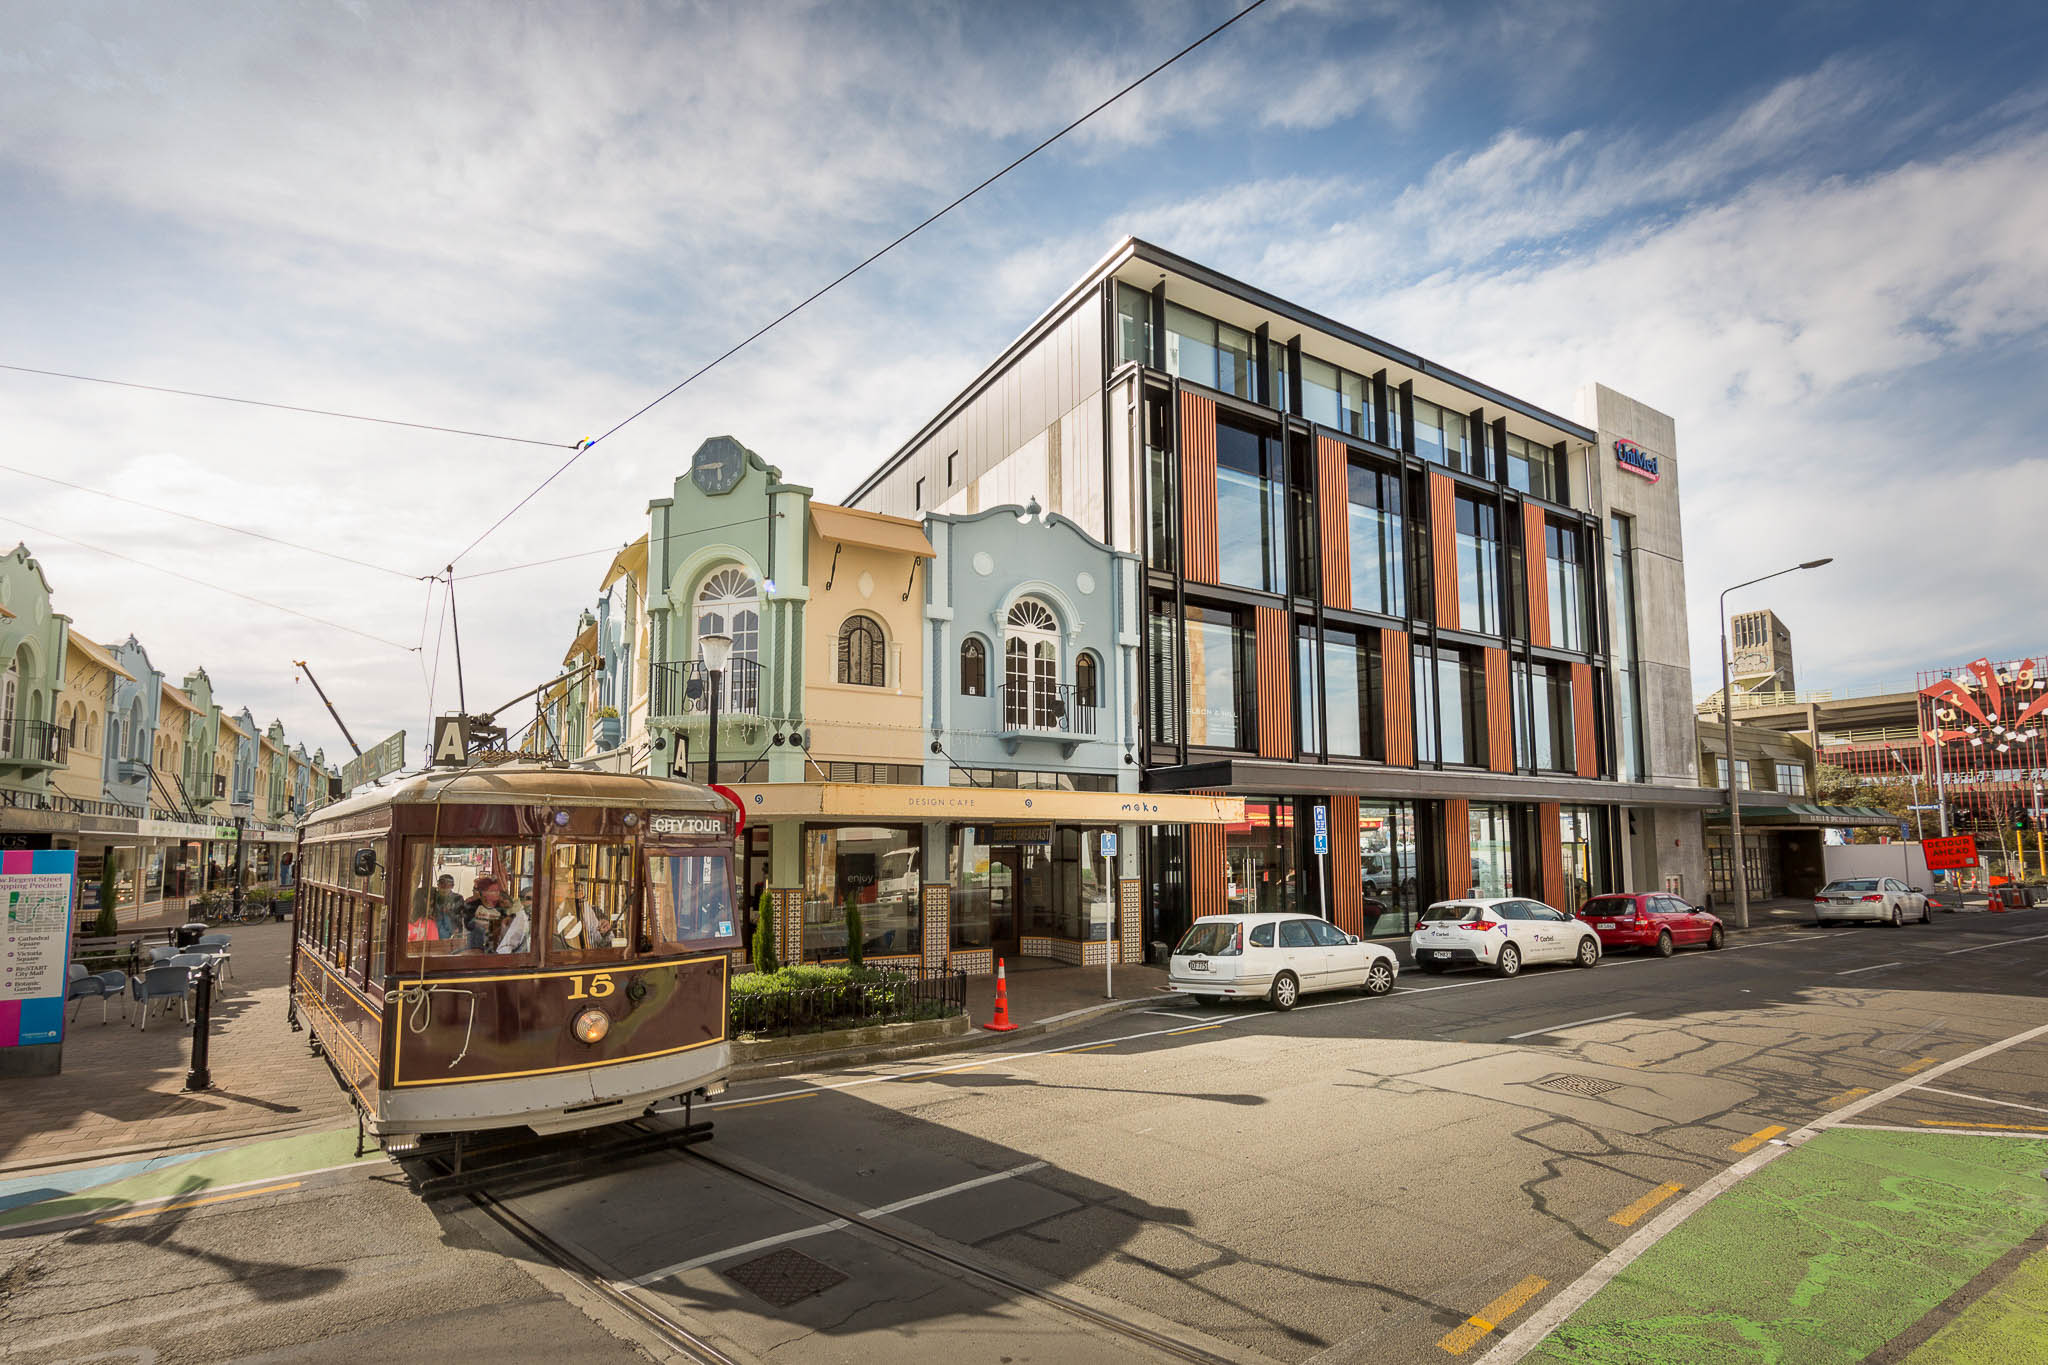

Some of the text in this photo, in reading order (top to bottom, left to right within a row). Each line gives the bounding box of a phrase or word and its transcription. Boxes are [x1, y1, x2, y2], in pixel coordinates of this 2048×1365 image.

[1617, 441, 1658, 474] UniMed
[435, 721, 465, 761] A
[673, 738, 687, 774] A
[908, 797, 976, 807] DESIGN CAFE
[655, 818, 721, 833] CITY TOUR
[1927, 838, 1970, 849] DETOUR
[1933, 847, 1969, 857] AHEAD
[8, 876, 35, 884] Regent
[847, 873, 873, 885] enjoy
[567, 973, 616, 1000] 15
